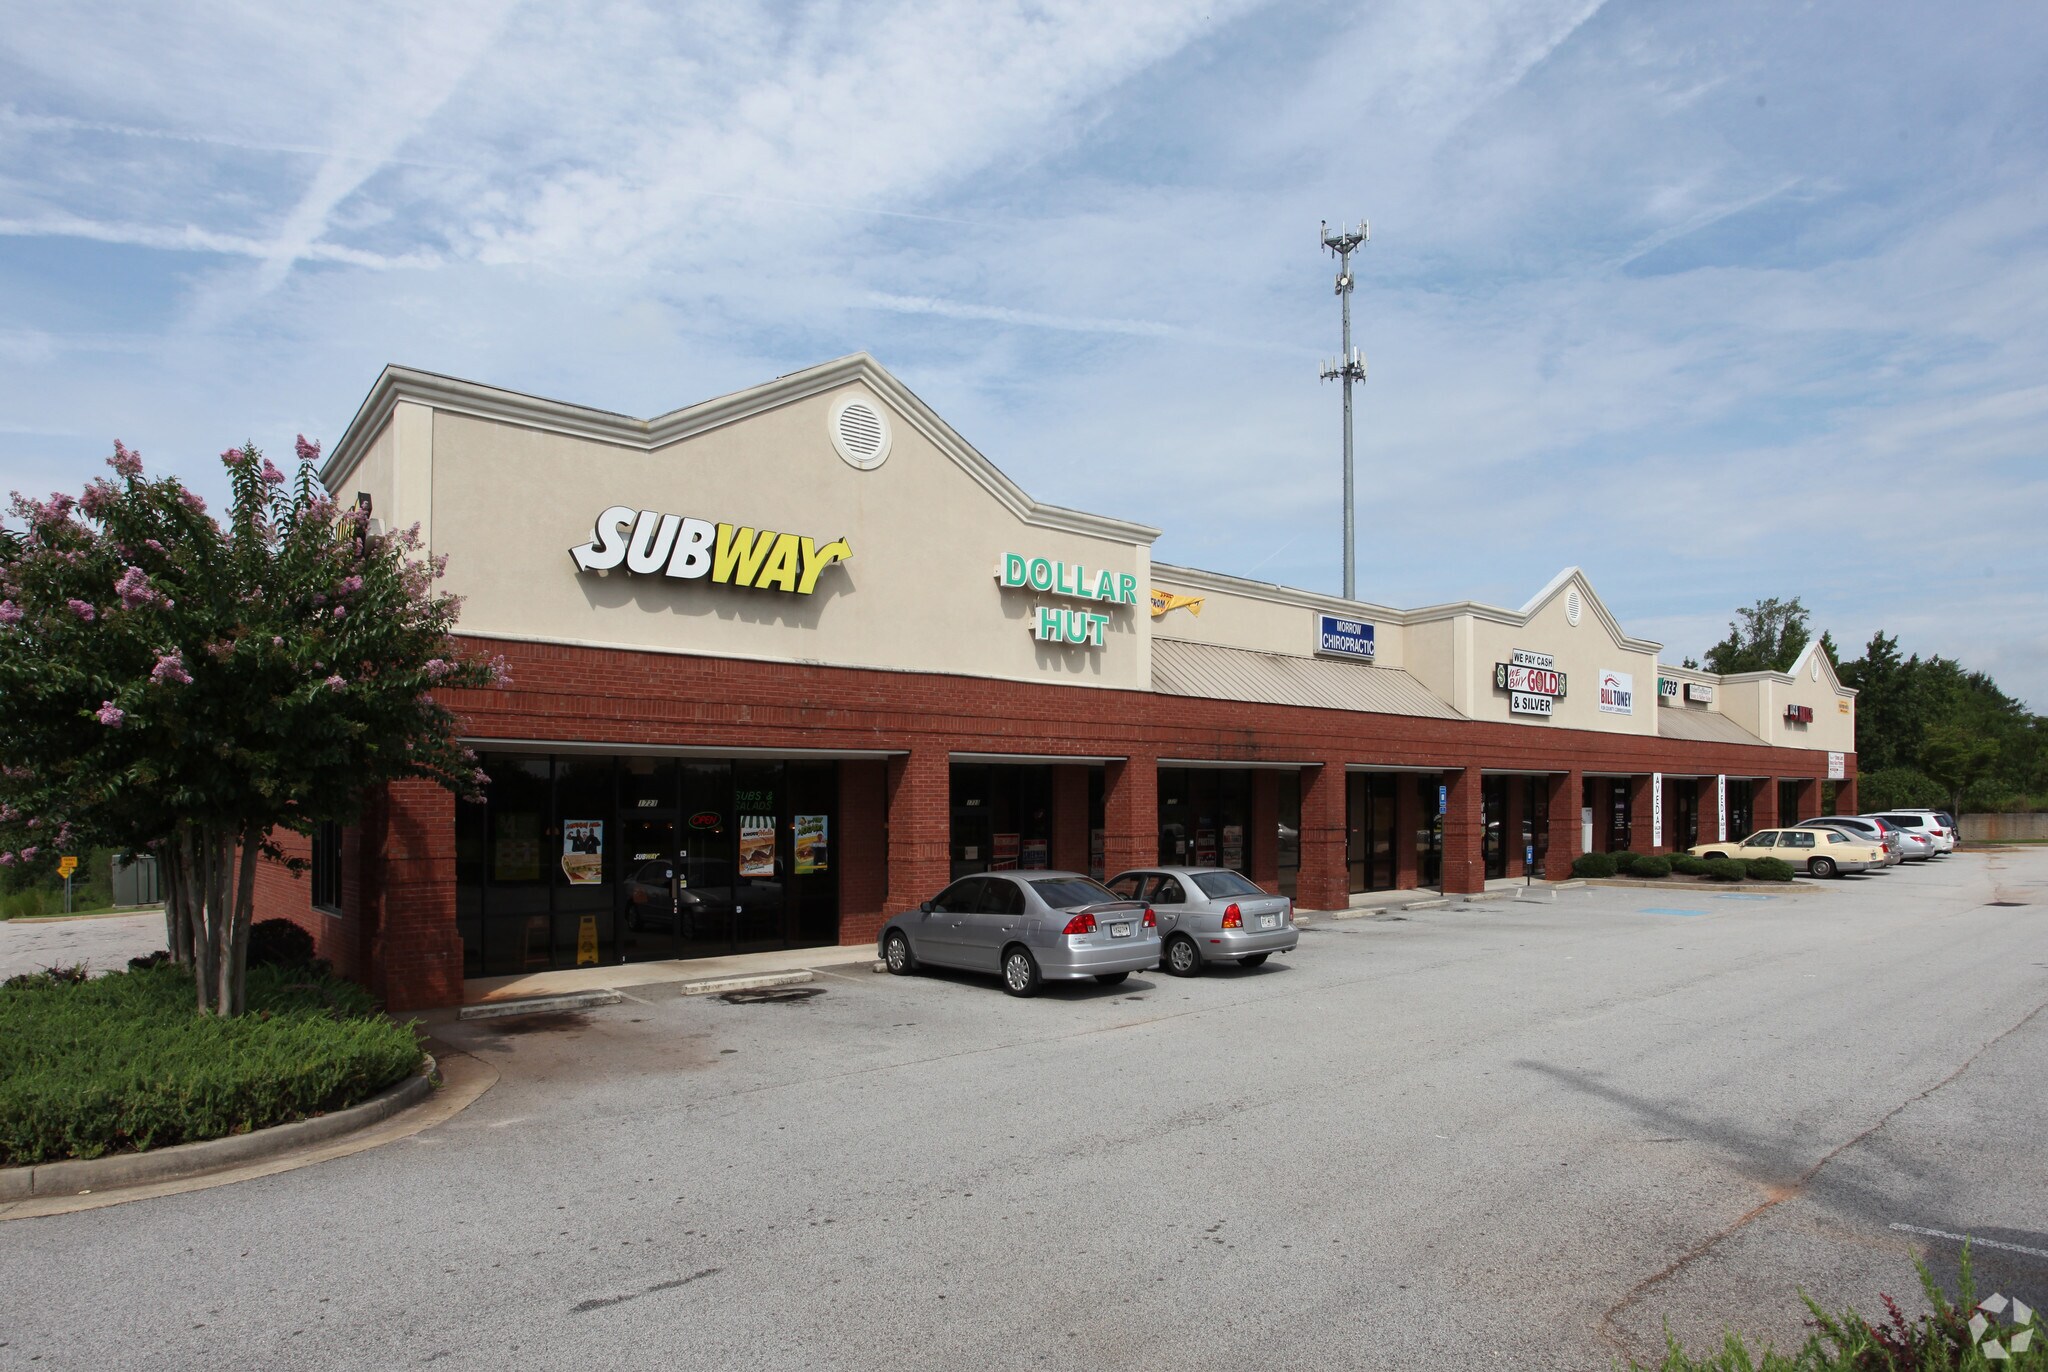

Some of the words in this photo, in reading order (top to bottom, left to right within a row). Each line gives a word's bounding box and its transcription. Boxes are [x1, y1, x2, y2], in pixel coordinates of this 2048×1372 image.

[568, 505, 853, 595] SUBWAY
[1001, 552, 1137, 605] DOLLAR
[1035, 606, 1109, 646] HUT
[1336, 620, 1362, 635] MORROW
[1322, 633, 1375, 655] CHIROPRACTIC
[1514, 653, 1524, 663] WE
[1525, 655, 1536, 665] PAY
[1537, 657, 1553, 667] CASH
[1509, 668, 1522, 678] WE
[1509, 676, 1527, 689] BUY
[1527, 669, 1558, 694] GOLD
[1662, 679, 1678, 696] 1733
[1514, 696, 1520, 709] &
[1522, 697, 1551, 712] SILVER
[1601, 688, 1613, 705] BILL
[1613, 690, 1632, 707] TONEY
[692, 815, 719, 826] OPEN
[634, 853, 661, 861] SUBWAY
